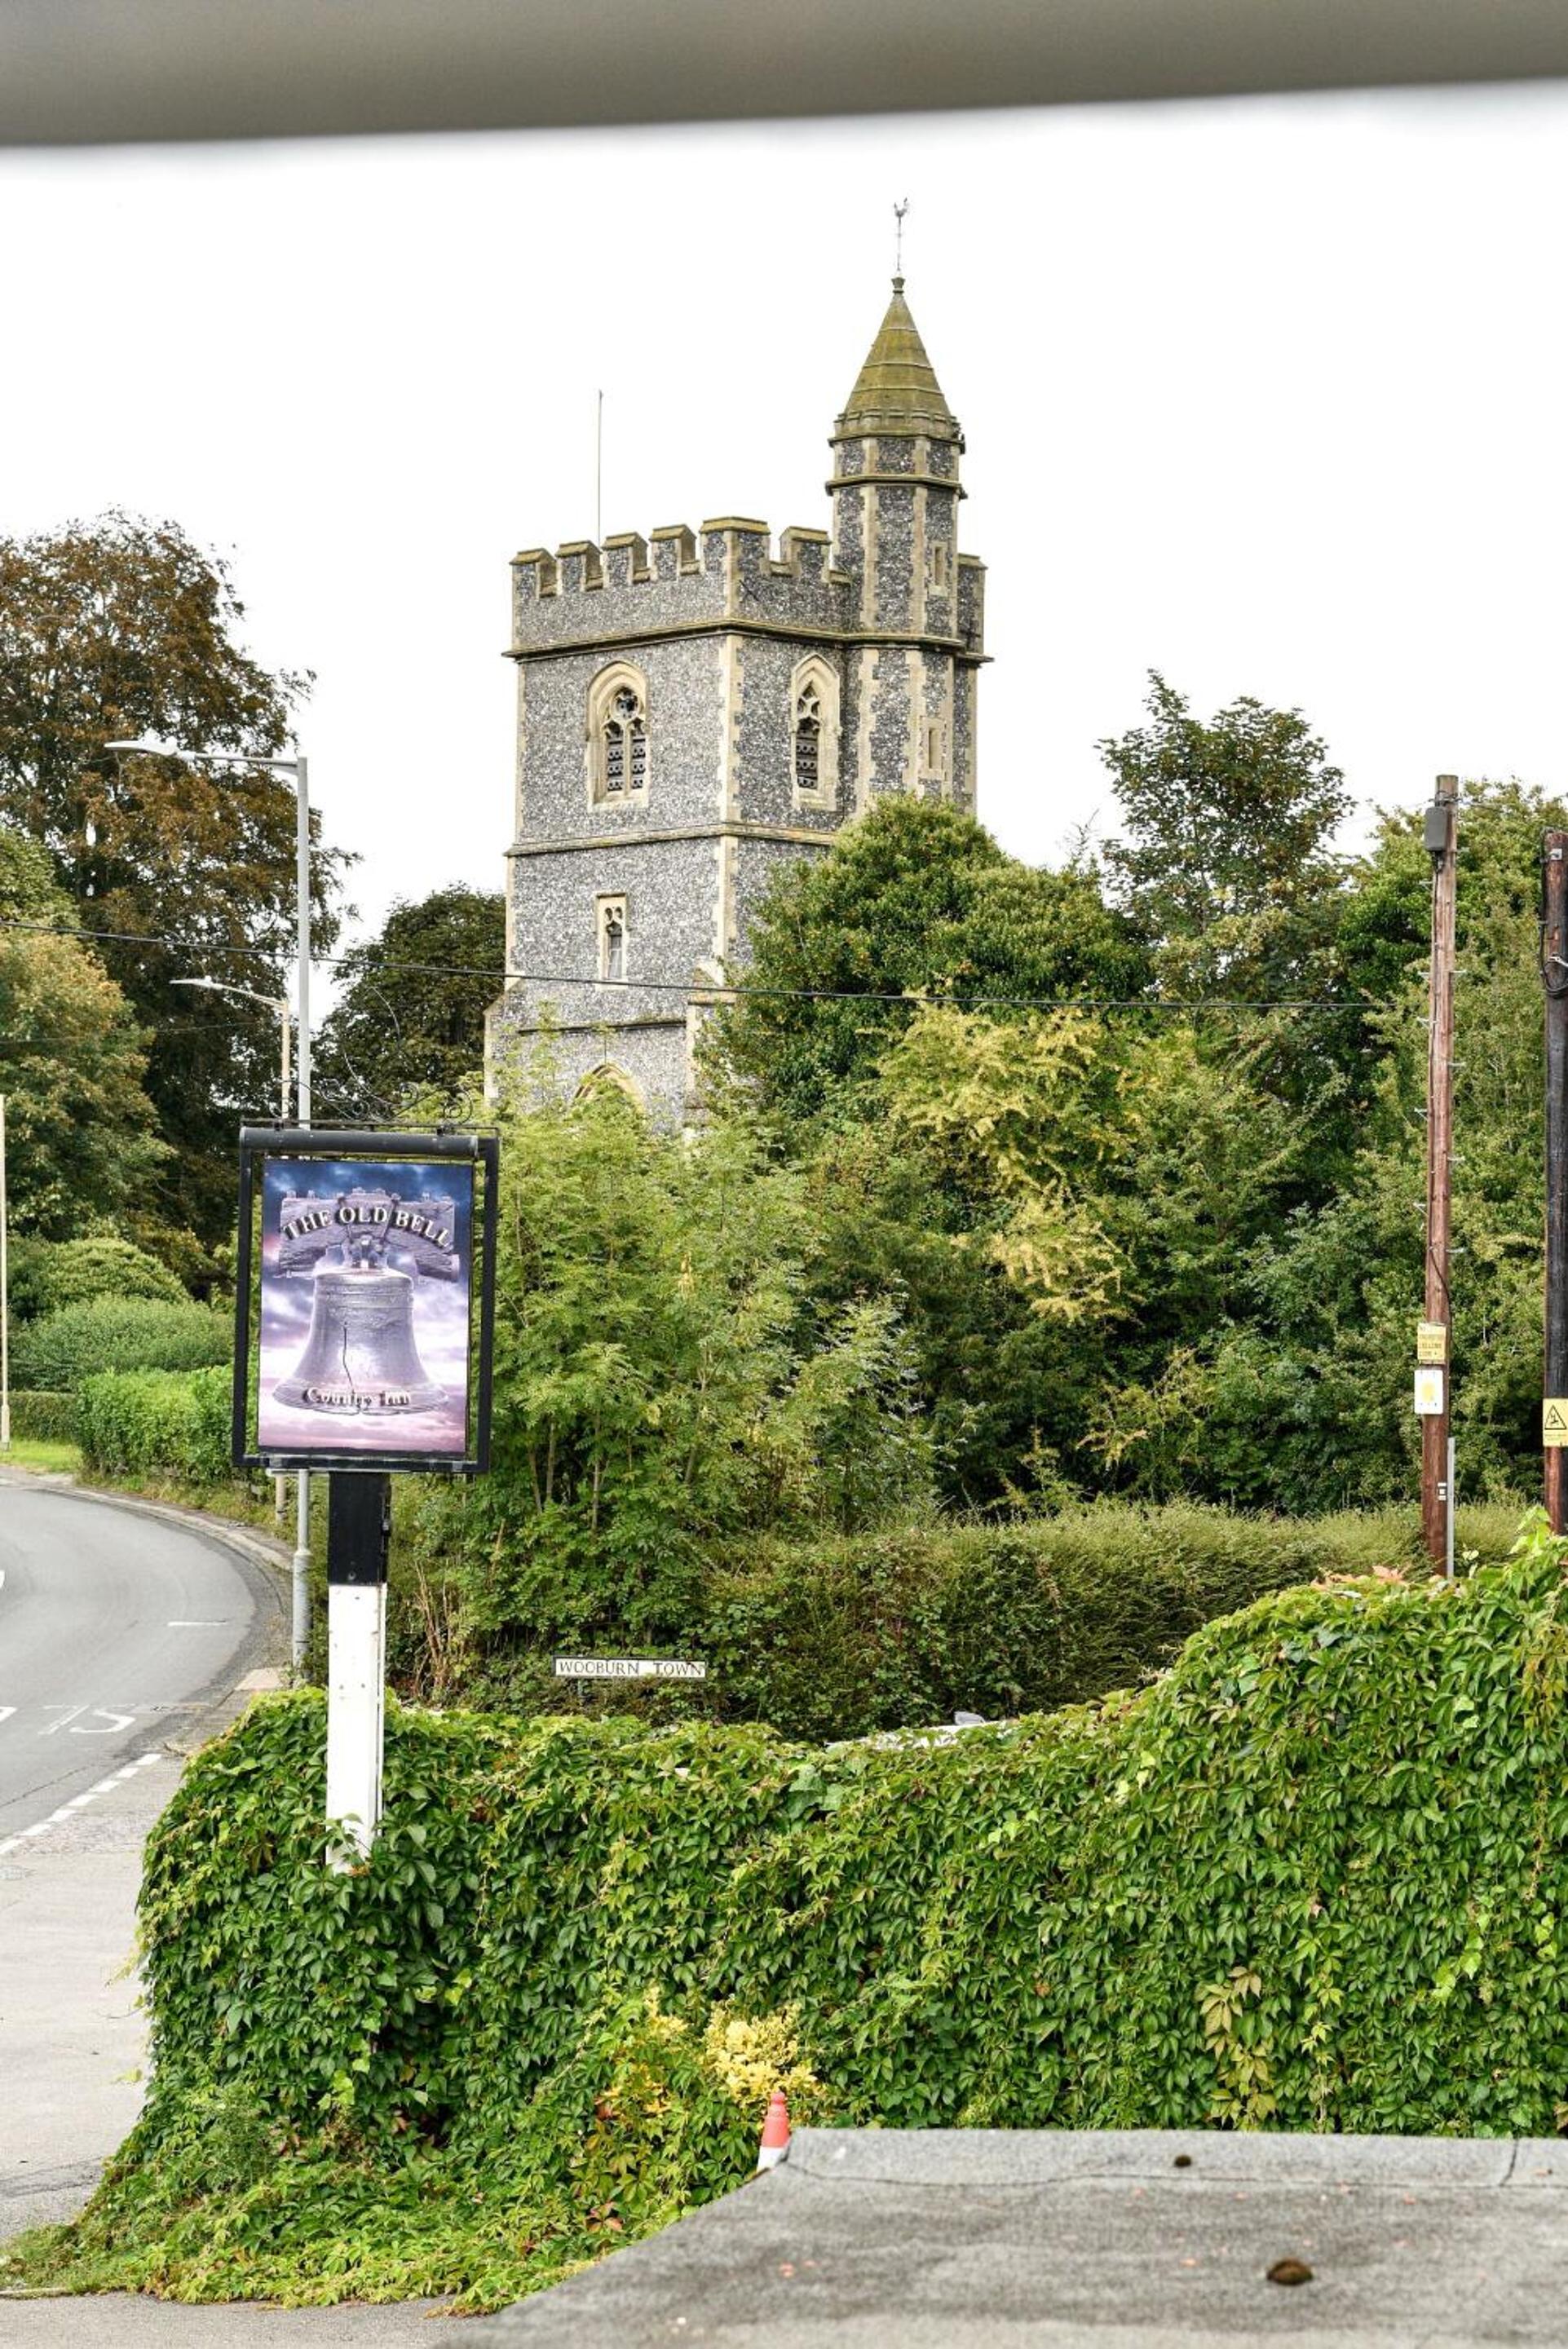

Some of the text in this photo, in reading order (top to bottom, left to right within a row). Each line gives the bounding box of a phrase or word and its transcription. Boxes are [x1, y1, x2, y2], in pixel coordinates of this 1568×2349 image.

[282, 1206, 449, 1247] THE OLD BELL
[306, 1387, 411, 1409] Country Inn
[559, 1660, 702, 1676] WOOBURN TOWN
